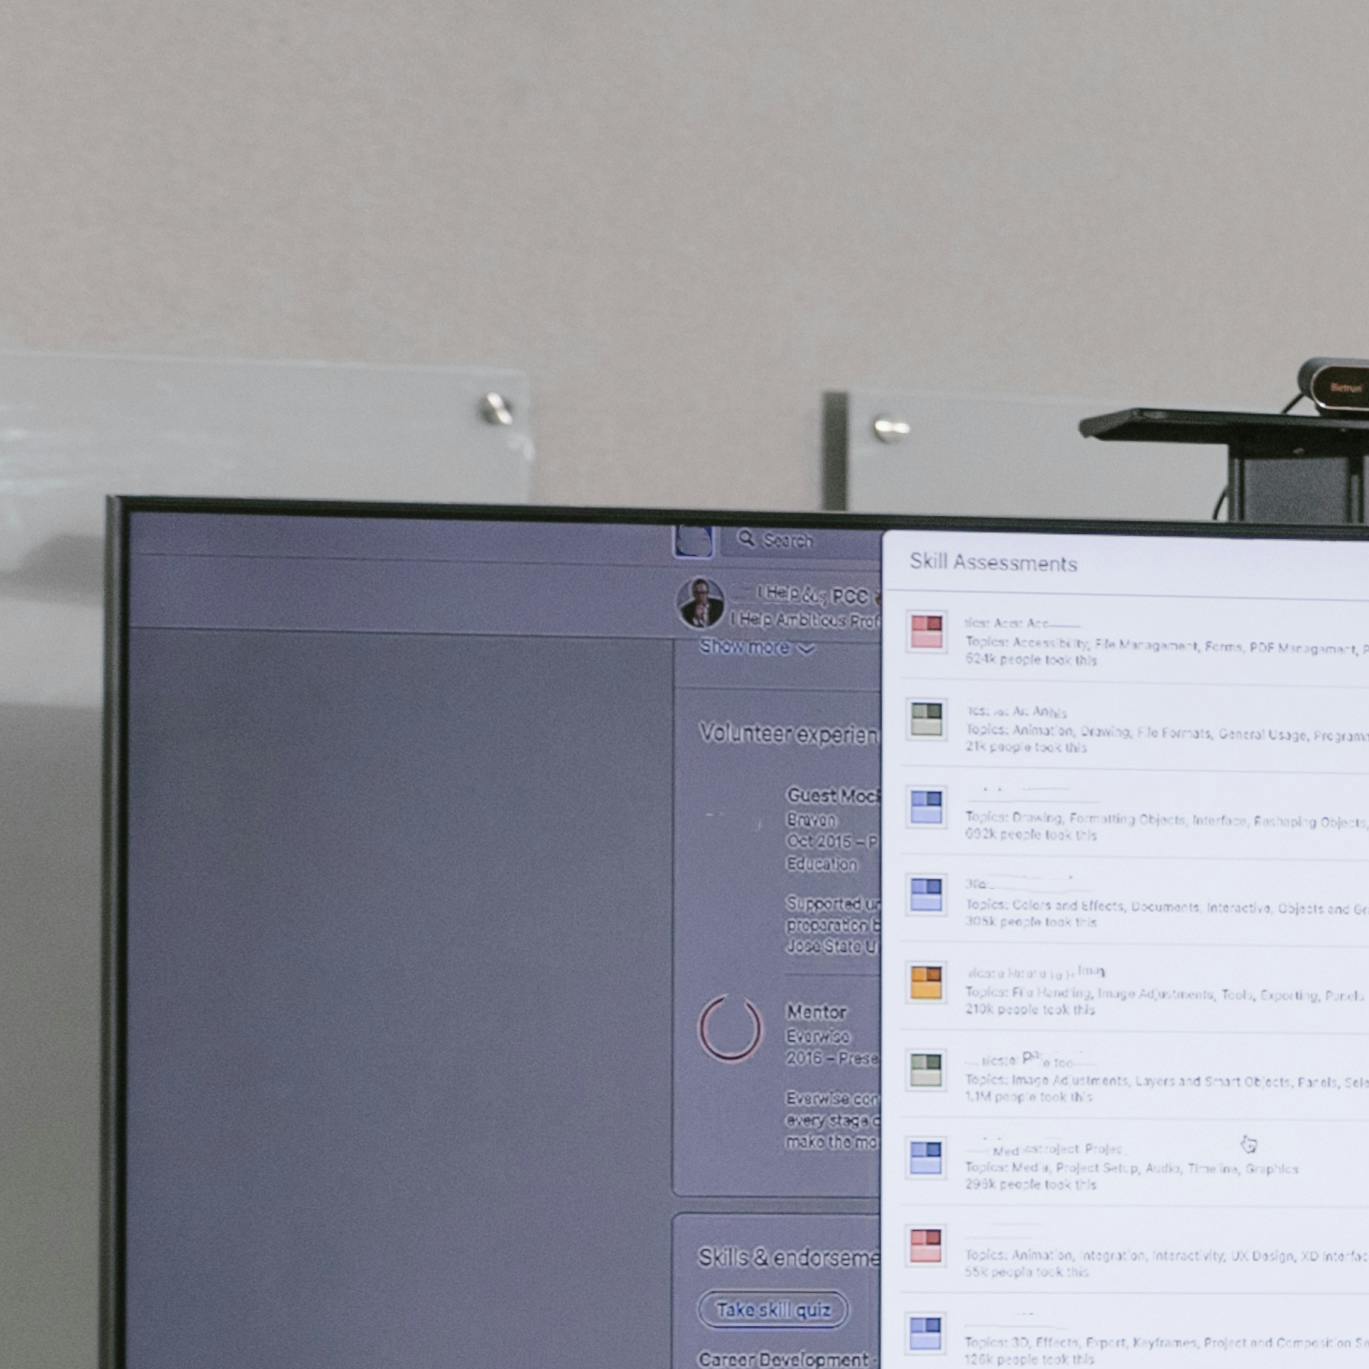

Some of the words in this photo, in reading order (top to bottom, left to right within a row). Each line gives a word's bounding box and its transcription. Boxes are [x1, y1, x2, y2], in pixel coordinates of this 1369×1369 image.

[763, 533, 814, 549] Search
[910, 552, 947, 570] Skill
[953, 554, 1078, 573] Assessments
[740, 614, 773, 628] Help
[700, 639, 743, 655] Show
[749, 643, 791, 655] more
[699, 722, 793, 743] Volunteer
[797, 726, 879, 748] experien
[787, 788, 837, 804] Guest
[787, 835, 813, 850] Oct
[787, 857, 858, 872] Education
[787, 897, 861, 912] Supported
[786, 939, 821, 954] Jose
[825, 939, 861, 954] State
[787, 1004, 847, 1020] Mentor
[787, 1029, 850, 1044] Everwise
[787, 1052, 822, 1066] 2016
[787, 1092, 849, 1106] Everwise
[786, 1115, 824, 1130] every
[829, 1115, 869, 1130] stage
[786, 1135, 824, 1150] make
[828, 1135, 851, 1150] the
[699, 1247, 749, 1268] Skills
[754, 1247, 768, 1268] &
[717, 1301, 755, 1318] Take
[759, 1301, 790, 1318] skill
[796, 1302, 831, 1321] quiz
[698, 1351, 755, 1368] Career
